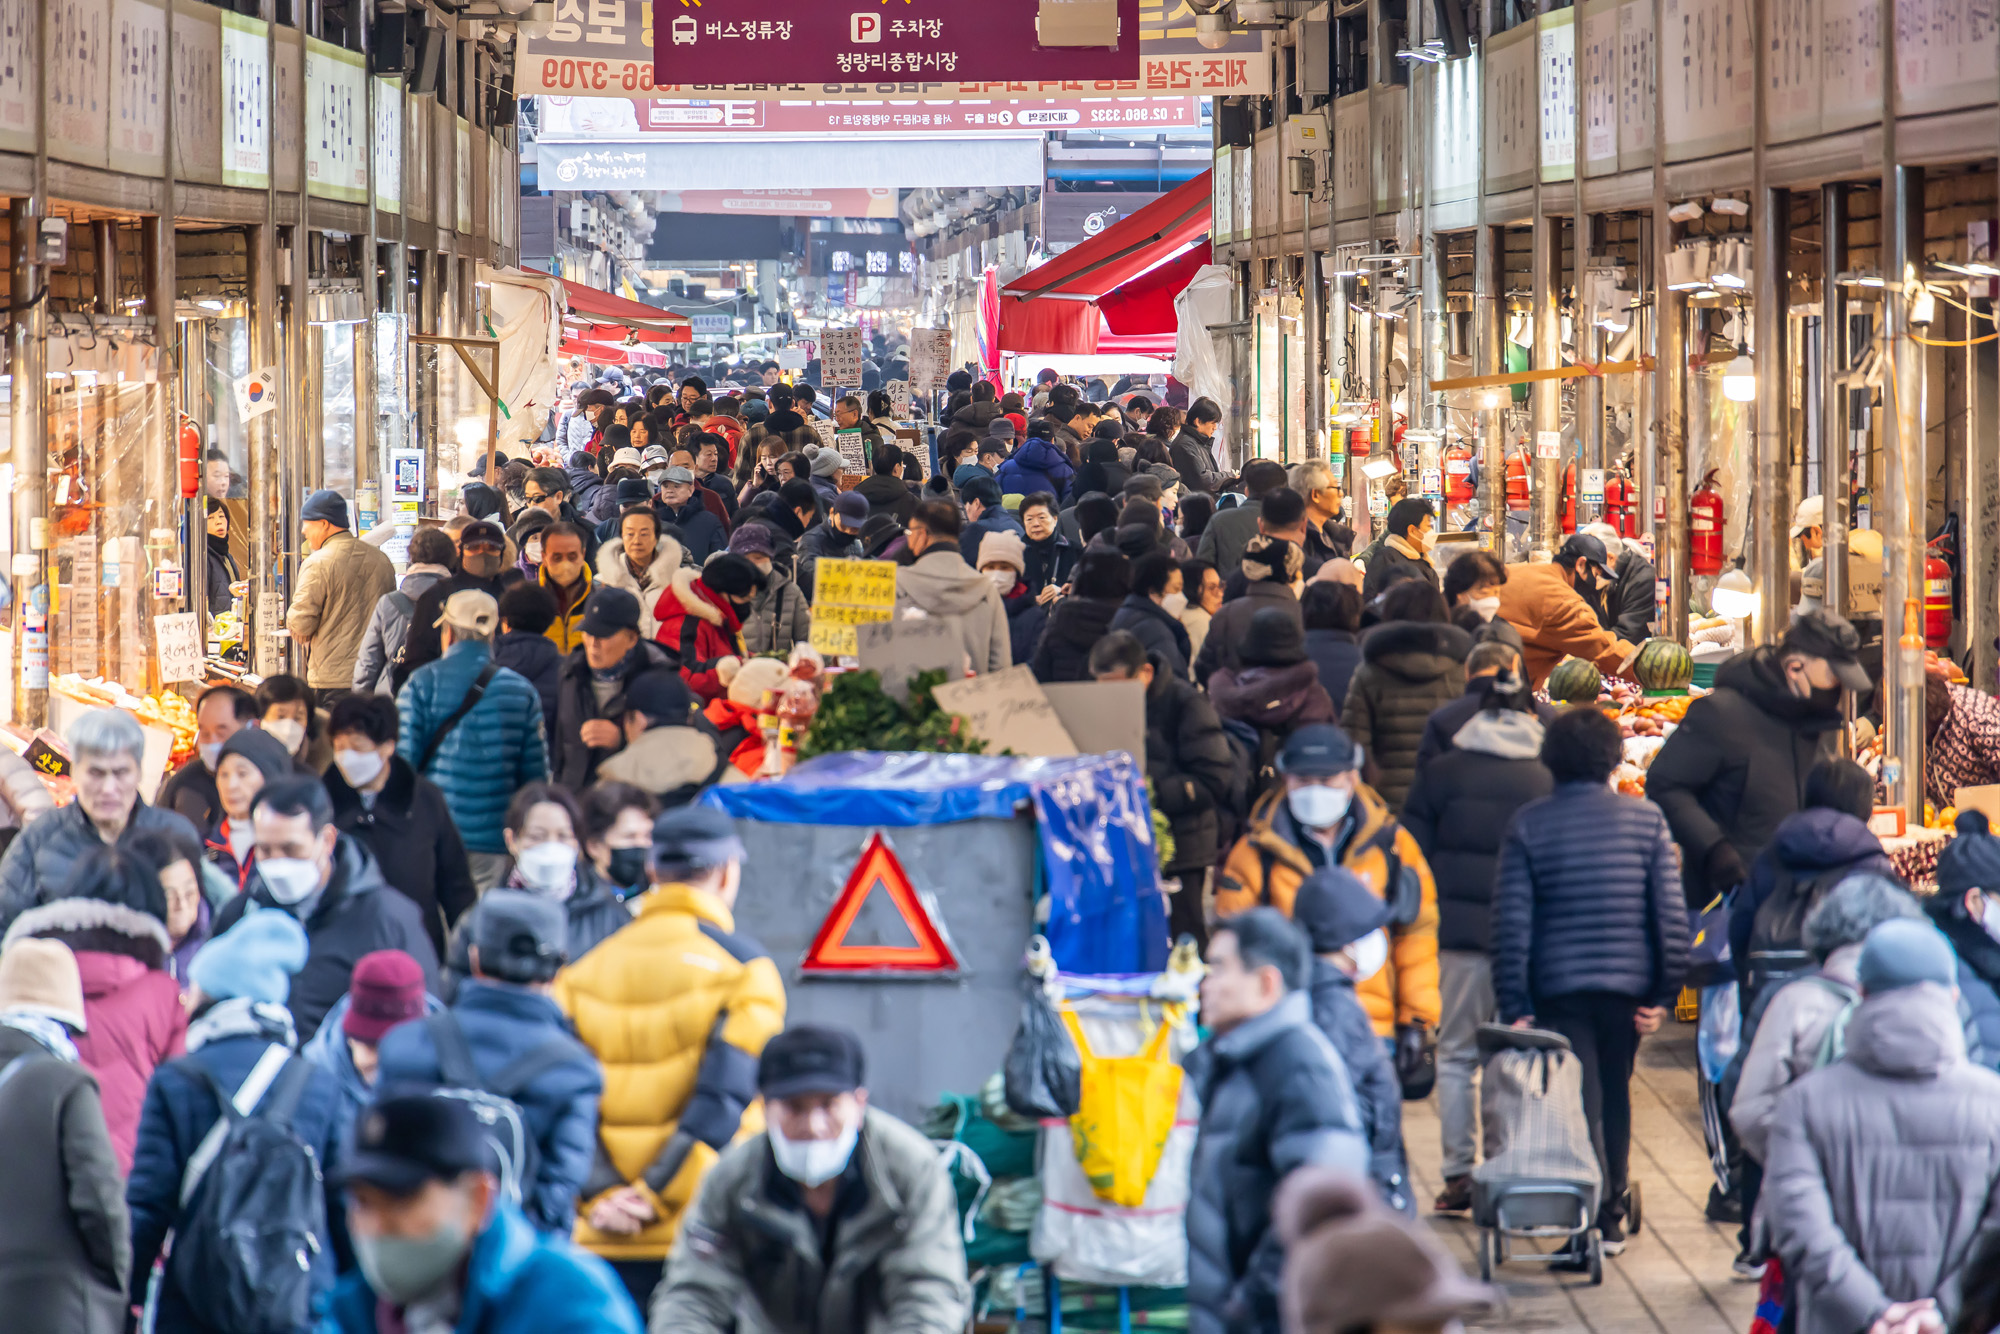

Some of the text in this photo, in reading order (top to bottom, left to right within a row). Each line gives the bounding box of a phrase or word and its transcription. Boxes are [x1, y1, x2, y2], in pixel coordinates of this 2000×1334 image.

[705, 20, 793, 40] 버스정류장
[889, 18, 943, 39] 주차장
[837, 52, 958, 73] 청량리종합시장
